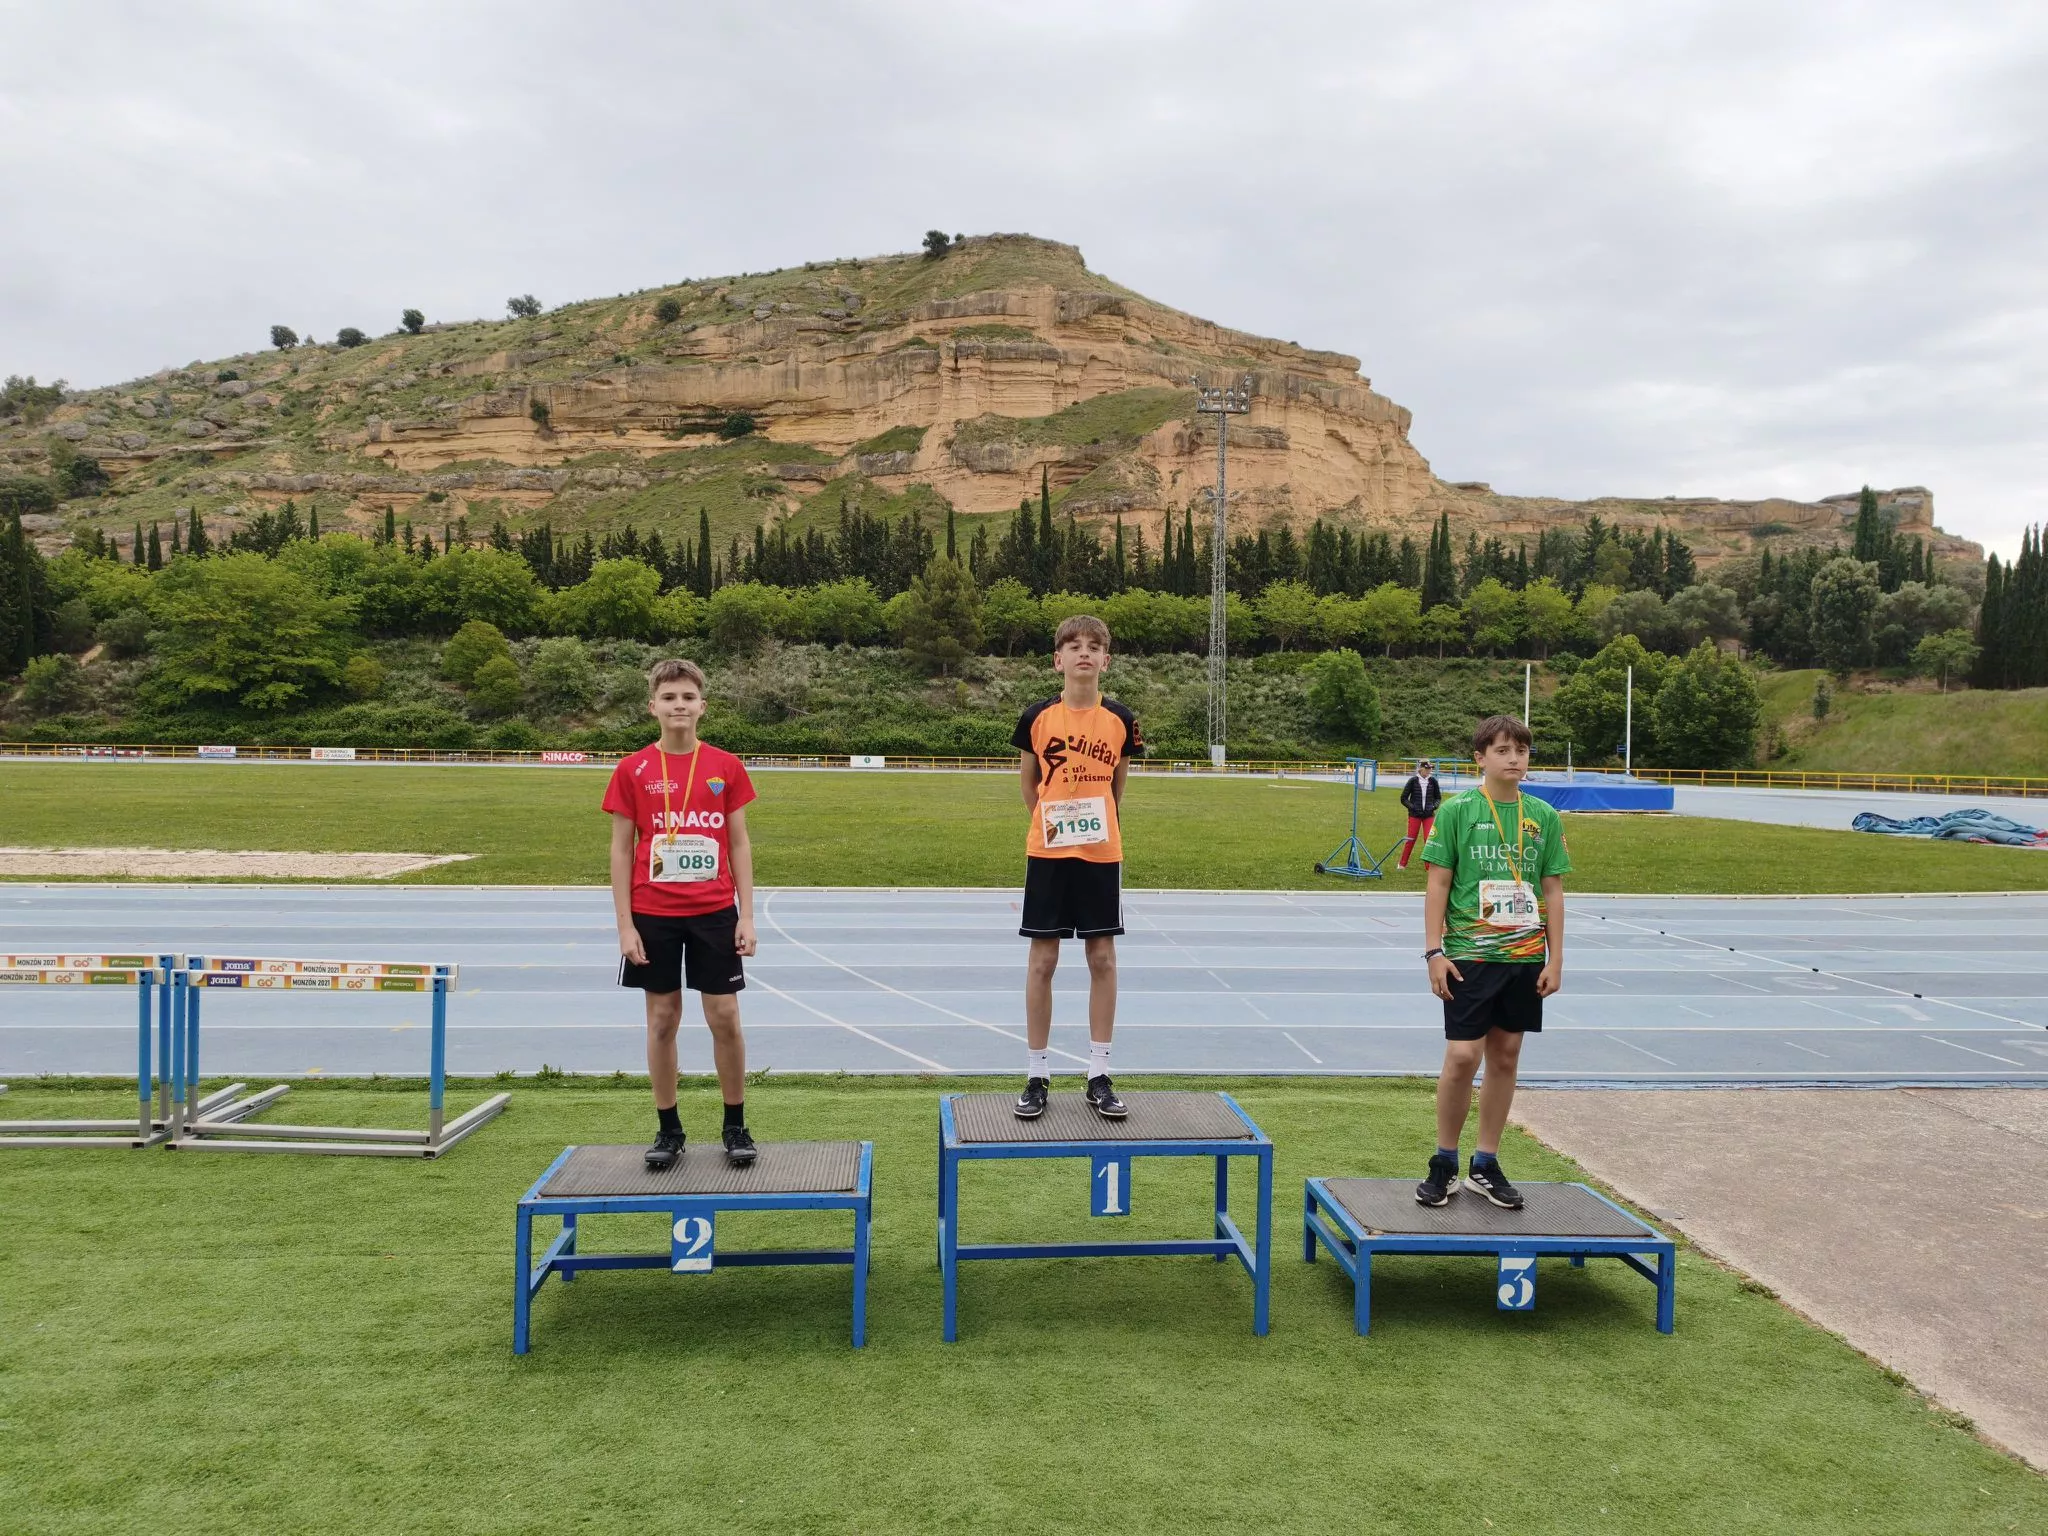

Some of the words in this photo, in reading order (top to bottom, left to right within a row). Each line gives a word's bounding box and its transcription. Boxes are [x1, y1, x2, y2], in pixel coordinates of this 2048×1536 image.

[542, 752, 583, 762] HINACO
[1056, 817, 1102, 834] 1196
[679, 855, 715, 869] 089
[1493, 900, 1534, 914] 116
[16, 958, 42, 967] MONZÓN
[327, 966, 340, 974] 2021
[292, 977, 317, 986] MONZÓN
[1098, 1162, 1123, 1213] 1
[673, 1217, 713, 1271] 2
[1498, 1257, 1535, 1307] 3
